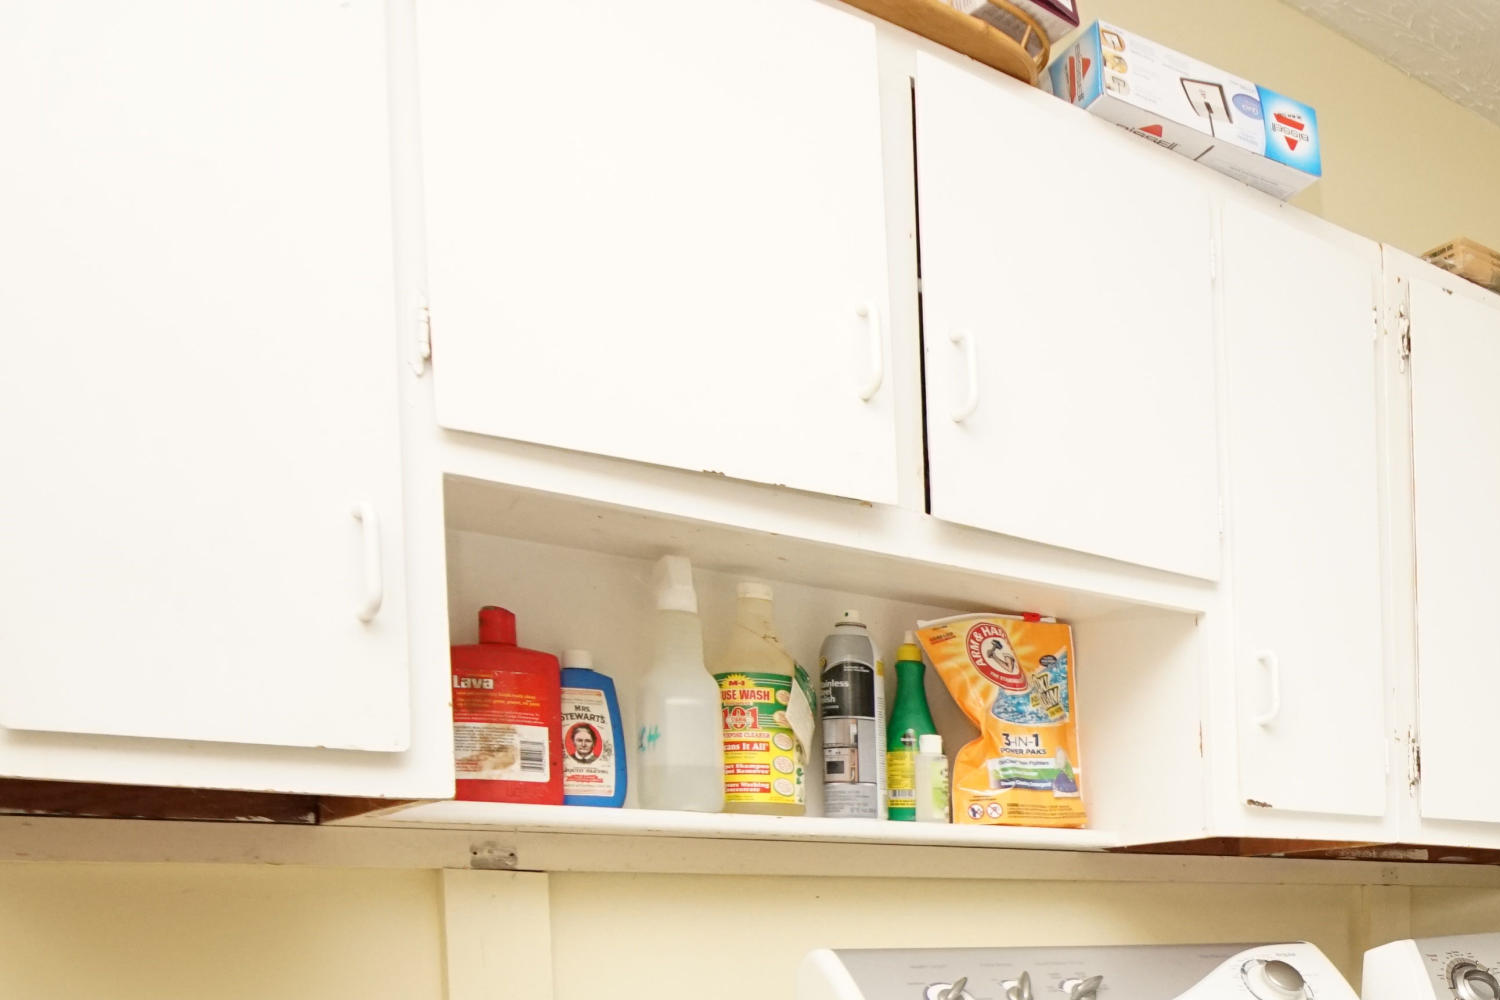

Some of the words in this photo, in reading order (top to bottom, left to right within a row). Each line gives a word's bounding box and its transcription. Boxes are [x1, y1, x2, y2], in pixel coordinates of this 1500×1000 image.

[453, 674, 495, 690] Lava
[739, 689, 770, 701] WASH
[1002, 732, 1040, 747] 3-IN-1
